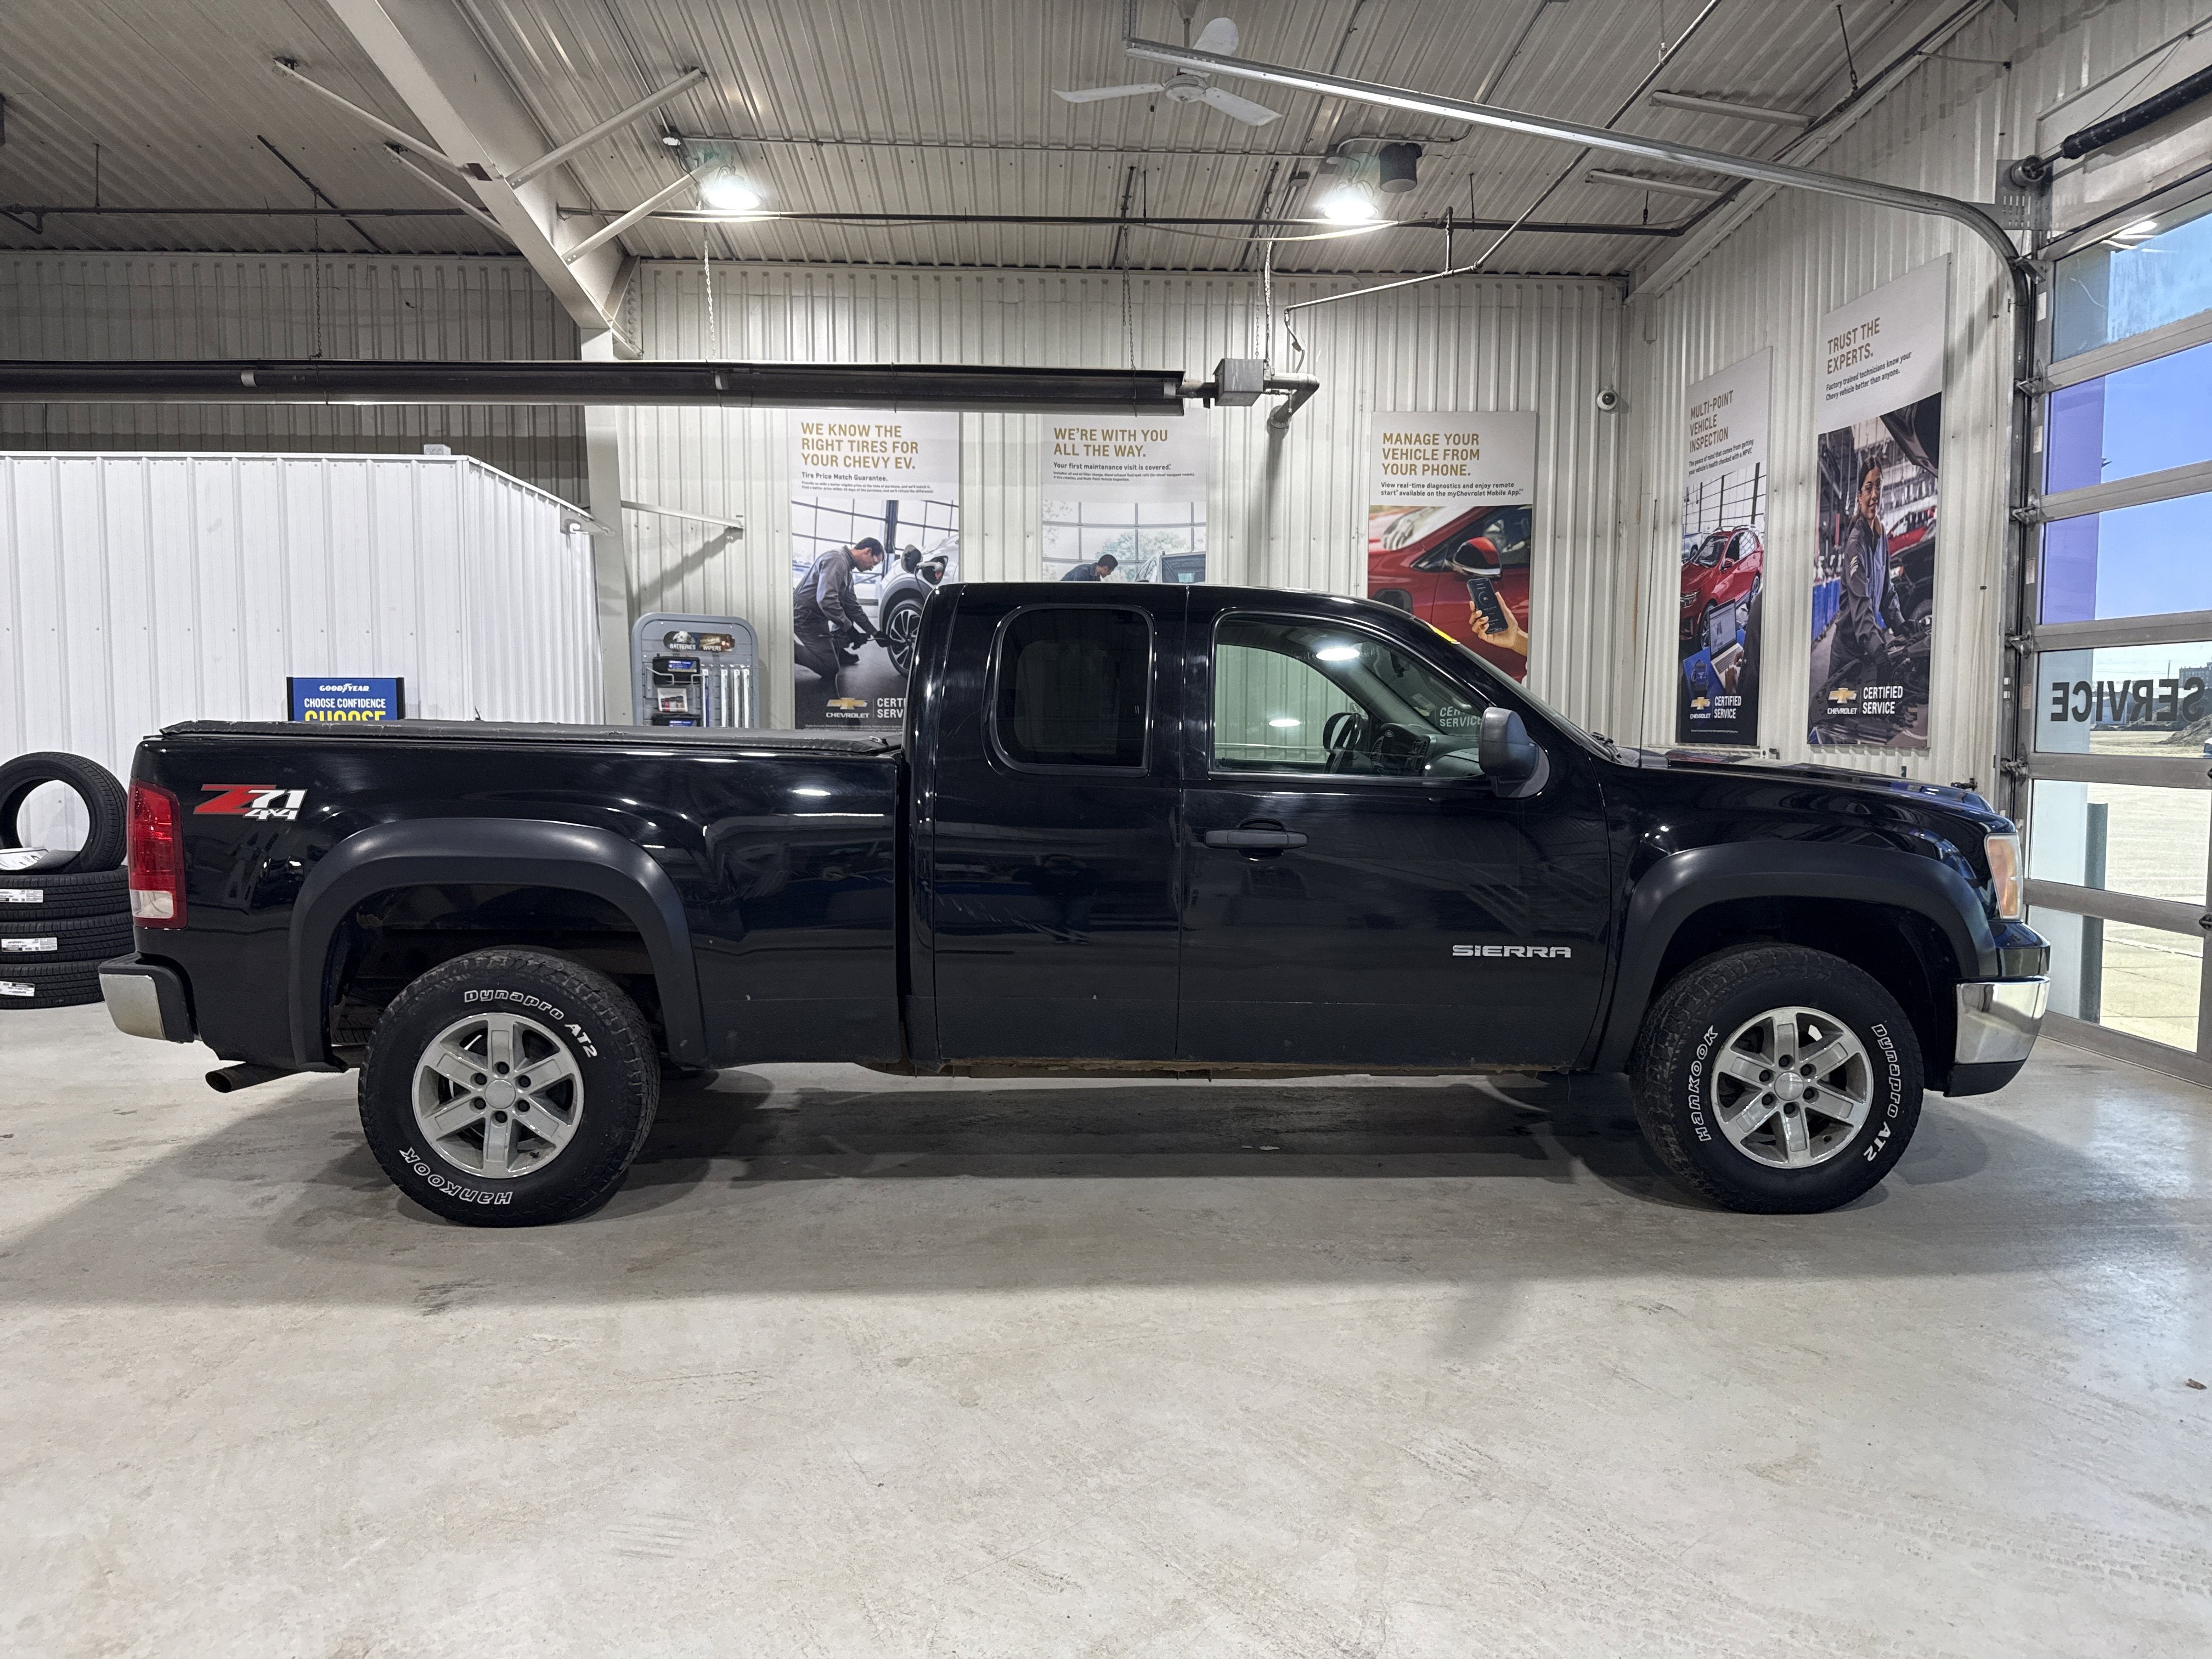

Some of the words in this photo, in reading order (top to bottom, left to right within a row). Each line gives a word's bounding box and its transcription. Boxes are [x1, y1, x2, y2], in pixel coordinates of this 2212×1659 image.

[1827, 328, 1858, 355] TRUST
[1860, 317, 1880, 340] THE
[1827, 342, 1874, 375] EXPERTS.
[1826, 380, 1842, 392] Factory
[1843, 373, 1859, 385] trained
[1860, 363, 1886, 379] technicians
[1886, 357, 1899, 368] know
[1900, 352, 1912, 364] your
[1826, 392, 1838, 401] Chevy
[1839, 385, 1854, 396] vehicle
[1855, 379, 1870, 391] better
[1870, 375, 1881, 385] than
[1882, 368, 1900, 380] anyone.
[1691, 390, 1734, 420] MULTI-POINT
[801, 422, 824, 436] WE
[828, 424, 871, 437] KNOW
[874, 425, 902, 438] THE
[1690, 414, 1717, 437] VEHICLE
[1053, 427, 1097, 442] WE'RE
[1101, 429, 1137, 442] WITH
[1141, 430, 1168, 442] YOU
[1383, 432, 1440, 445] MANAGE
[1444, 433, 1479, 445] YOUR
[1690, 426, 1729, 454] INSPECTION
[802, 437, 844, 452] RIGHT
[848, 439, 888, 454] TIRES
[892, 441, 919, 454] FOR
[1053, 443, 1080, 456] ALL
[1084, 444, 1110, 456] THE
[1114, 445, 1147, 457] WAY.
[801, 453, 839, 467] YOUR
[843, 455, 890, 469] CHEVY
[895, 456, 916, 469] EV.
[1383, 448, 1439, 461] VEHICLE
[1443, 449, 1480, 461] FROM
[1381, 463, 1417, 476] YOUR
[1422, 464, 1471, 476] PHONE.
[319, 683, 370, 693] GOODYEAR
[1863, 686, 1903, 699] CERTIFIED
[304, 698, 336, 708] CHOOSE
[337, 698, 386, 708] CONFIDENCE
[1714, 695, 1742, 707] CERTIFIED
[1863, 701, 1895, 714] SERVICE
[877, 709, 904, 719] SERV
[1714, 708, 1736, 719] SERVICE
[193, 783, 308, 815] Z71
[1452, 945, 1571, 958] SIERRA
[464, 989, 564, 1020] Dynapro
[565, 1023, 598, 1058] AT2
[1871, 1023, 1901, 1119] Dynapro
[1863, 1122, 1892, 1162] AT2
